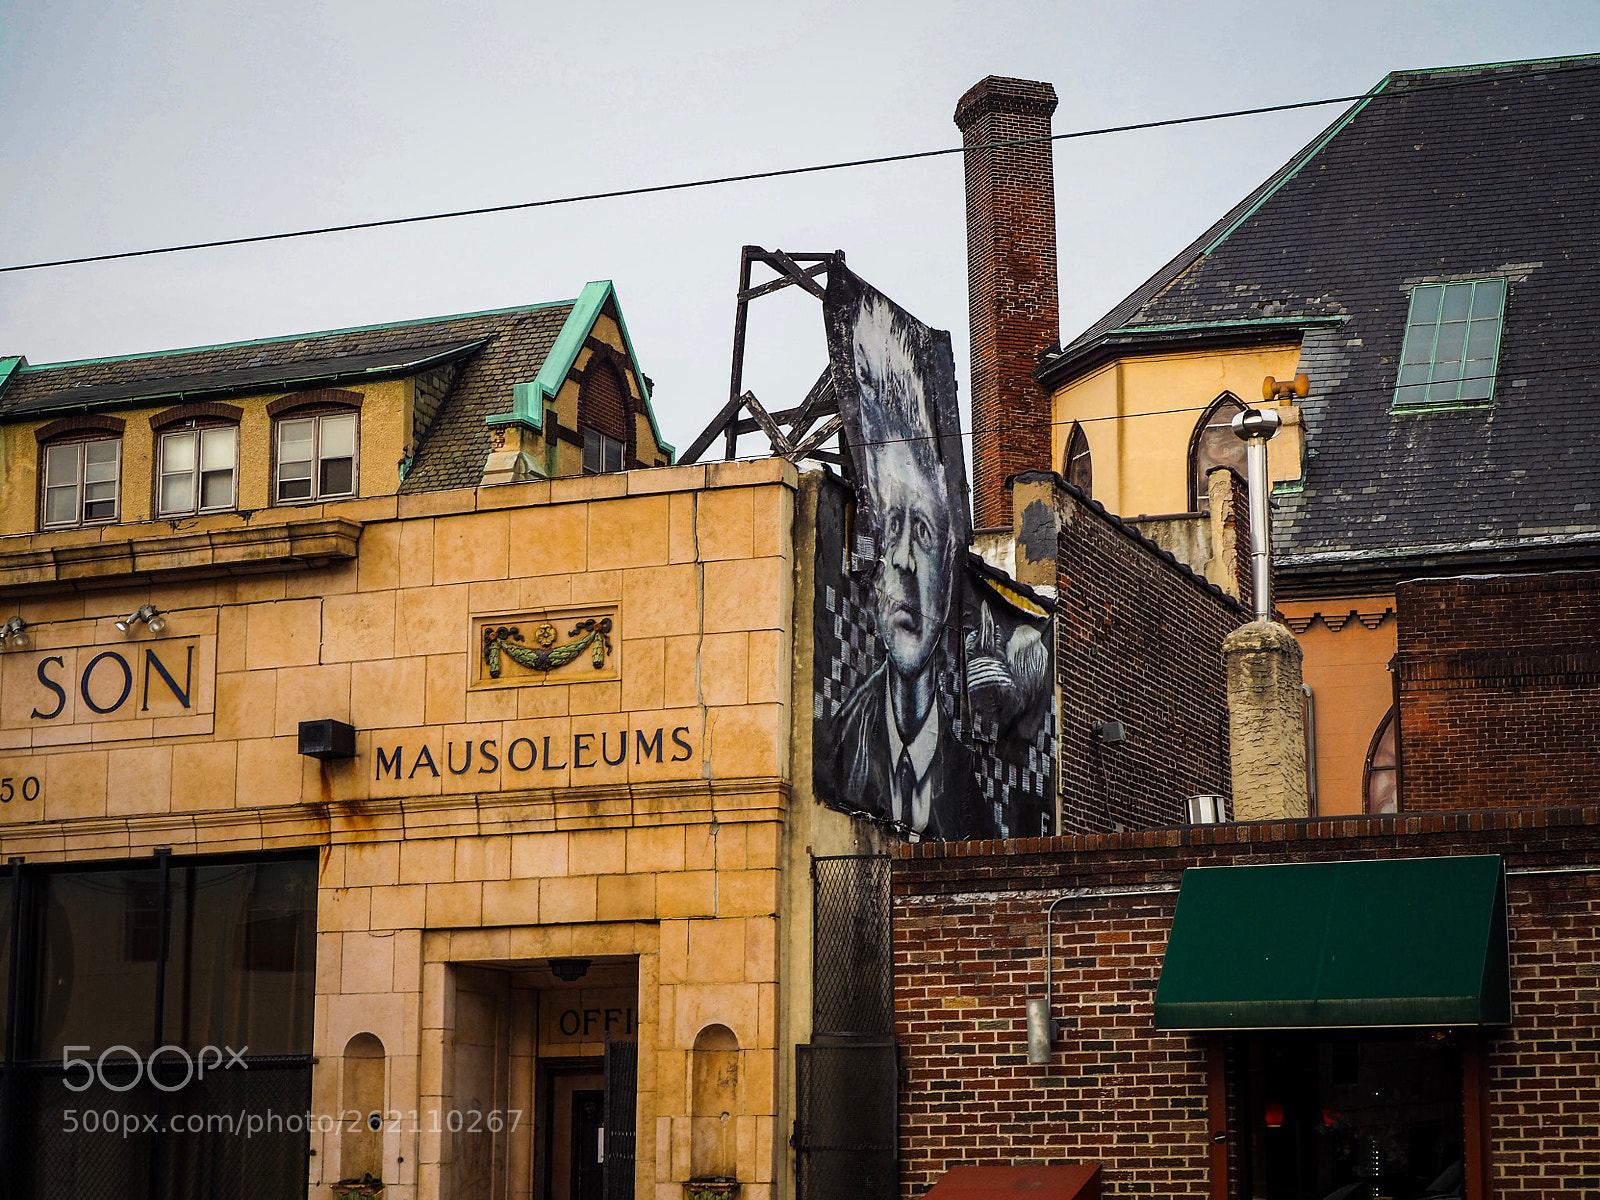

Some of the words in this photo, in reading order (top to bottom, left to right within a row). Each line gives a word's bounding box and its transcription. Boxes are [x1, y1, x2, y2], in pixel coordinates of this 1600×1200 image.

[31, 645, 195, 720] SON
[375, 726, 694, 781] MAUSOLEUMS
[559, 1007, 638, 1036] OFFI
